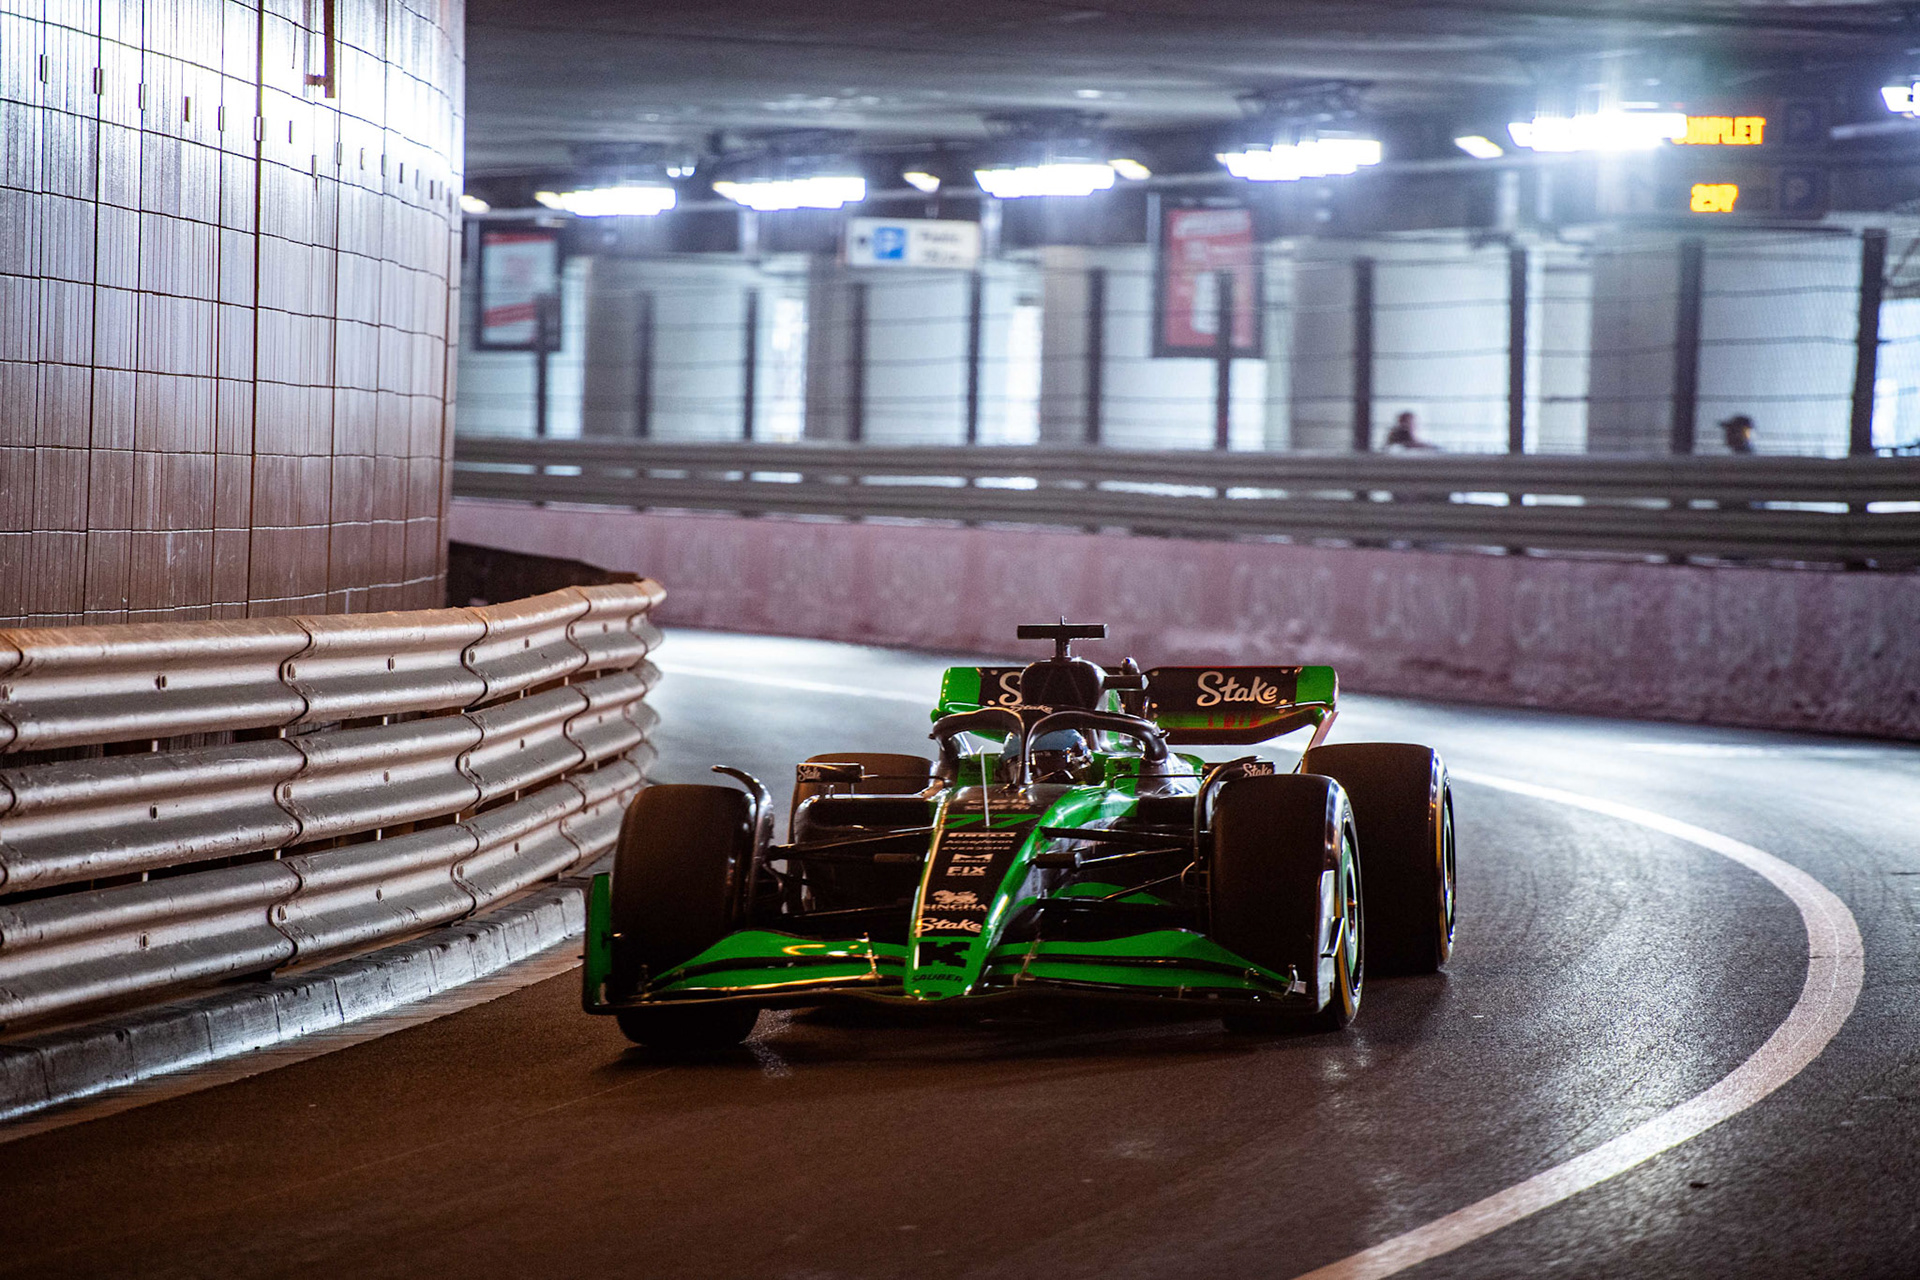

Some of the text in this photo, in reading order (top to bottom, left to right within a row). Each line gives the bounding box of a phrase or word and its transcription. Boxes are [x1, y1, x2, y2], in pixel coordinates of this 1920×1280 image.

[1197, 671, 1278, 707] Stake
[1243, 763, 1273, 777] Stake
[943, 813, 1041, 829] 77
[948, 866, 988, 874] FIX
[917, 917, 983, 933] Stake
[911, 973, 964, 983] SAUBER
